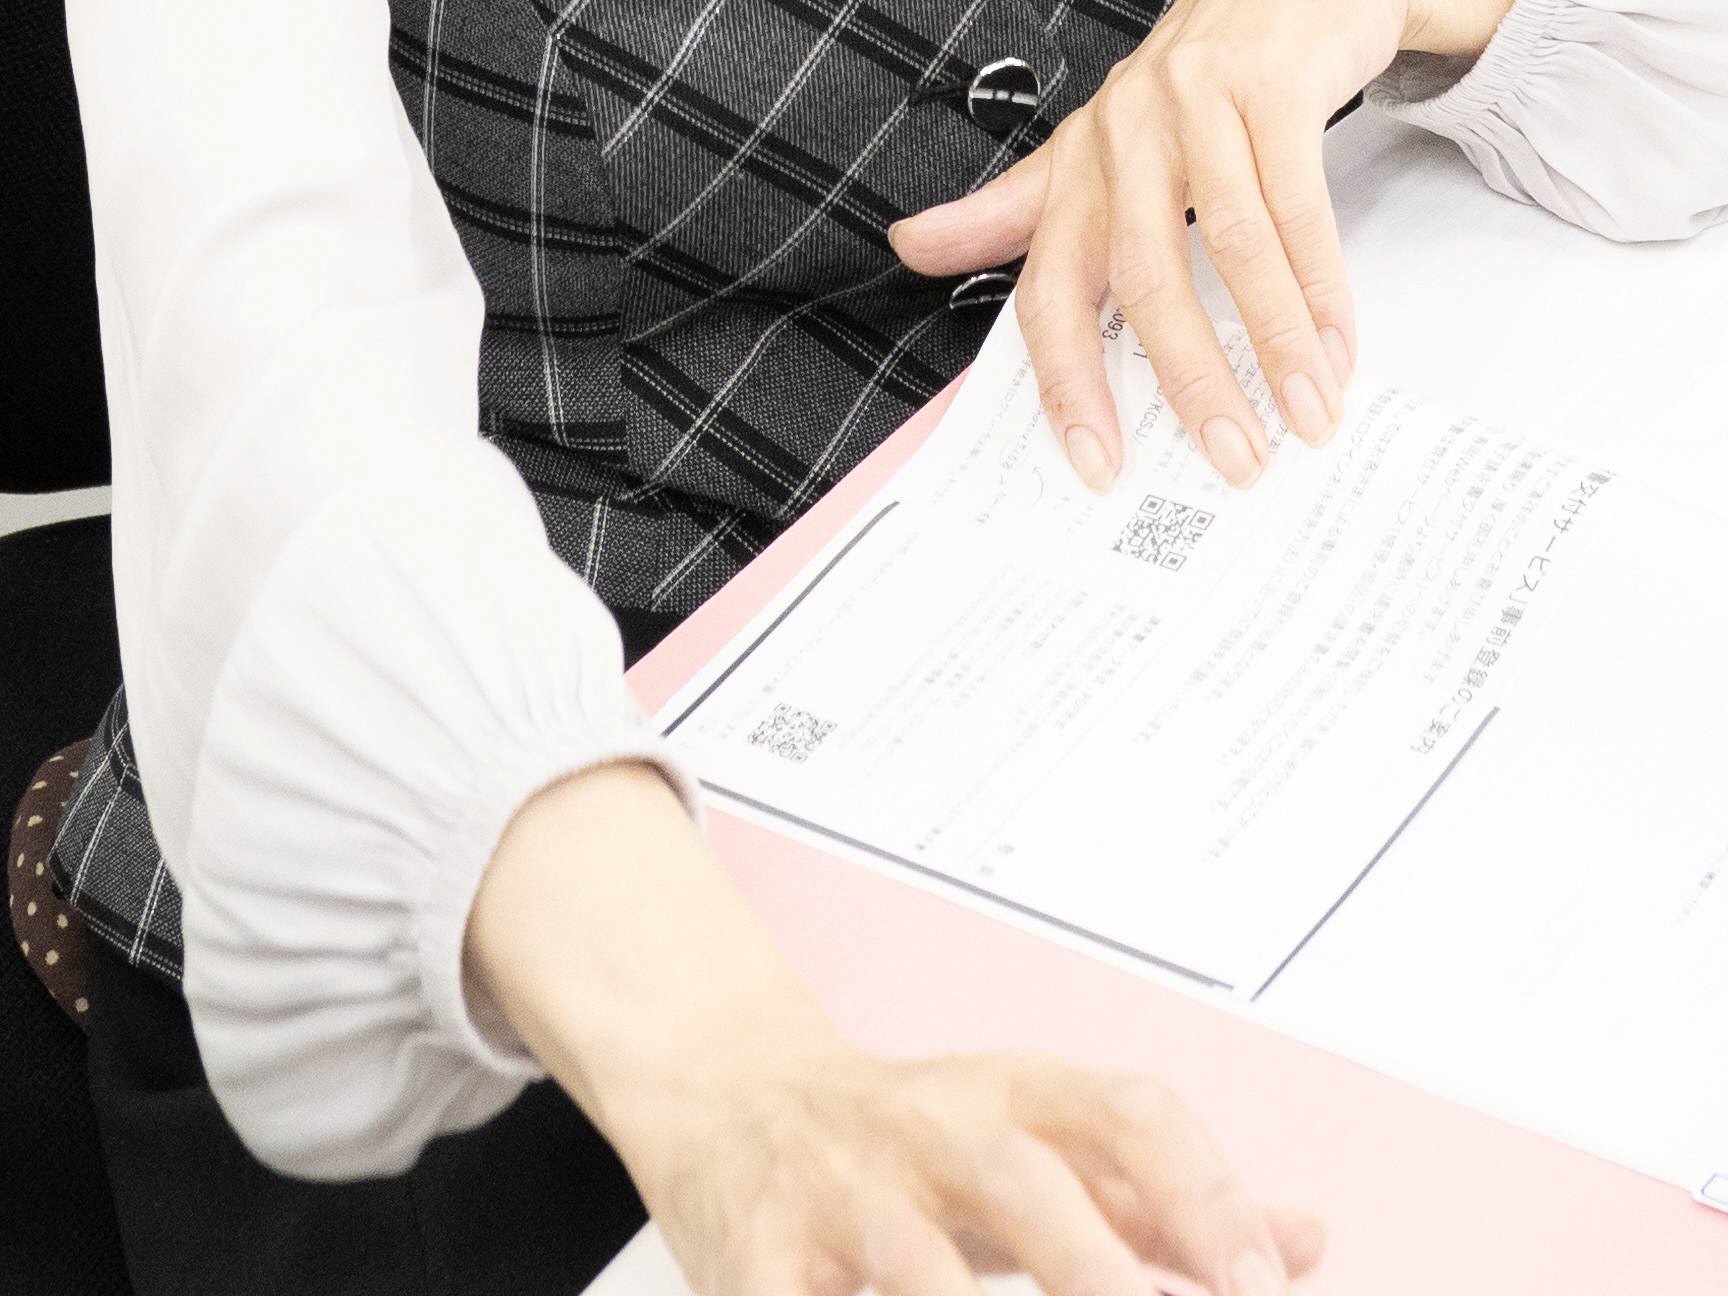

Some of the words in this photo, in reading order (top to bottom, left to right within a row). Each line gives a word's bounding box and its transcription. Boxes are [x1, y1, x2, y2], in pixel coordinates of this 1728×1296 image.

[1408, 467, 1619, 757] 書交付サービス」事前登録のご案内
